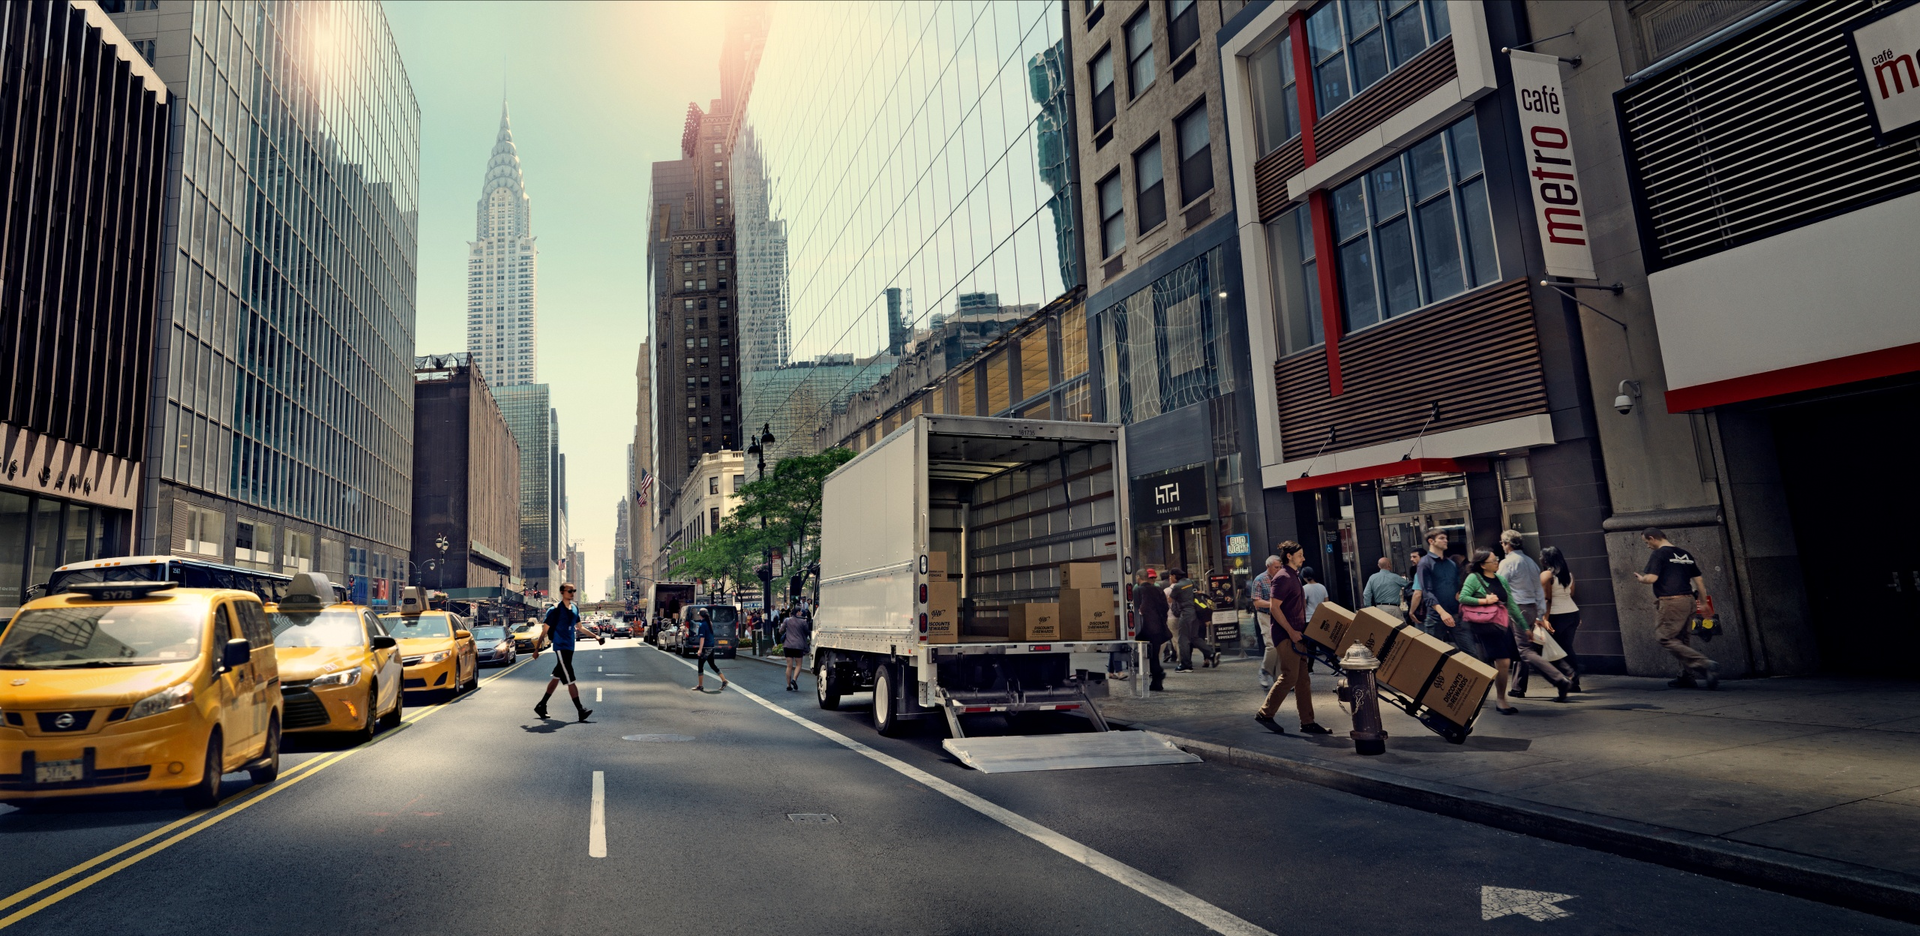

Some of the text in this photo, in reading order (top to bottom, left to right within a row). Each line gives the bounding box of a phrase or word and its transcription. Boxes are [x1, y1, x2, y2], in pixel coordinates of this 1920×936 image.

[1872, 48, 1894, 67] café
[1873, 49, 1920, 100] m
[1521, 85, 1560, 115] café
[1530, 125, 1586, 246] metro
[39, 465, 92, 496] BANK
[1229, 536, 1246, 545] BUD
[1391, 527, 1399, 537] A
[1228, 543, 1250, 553] LIGHT
[1443, 672, 1463, 703] DISCOUNTS
